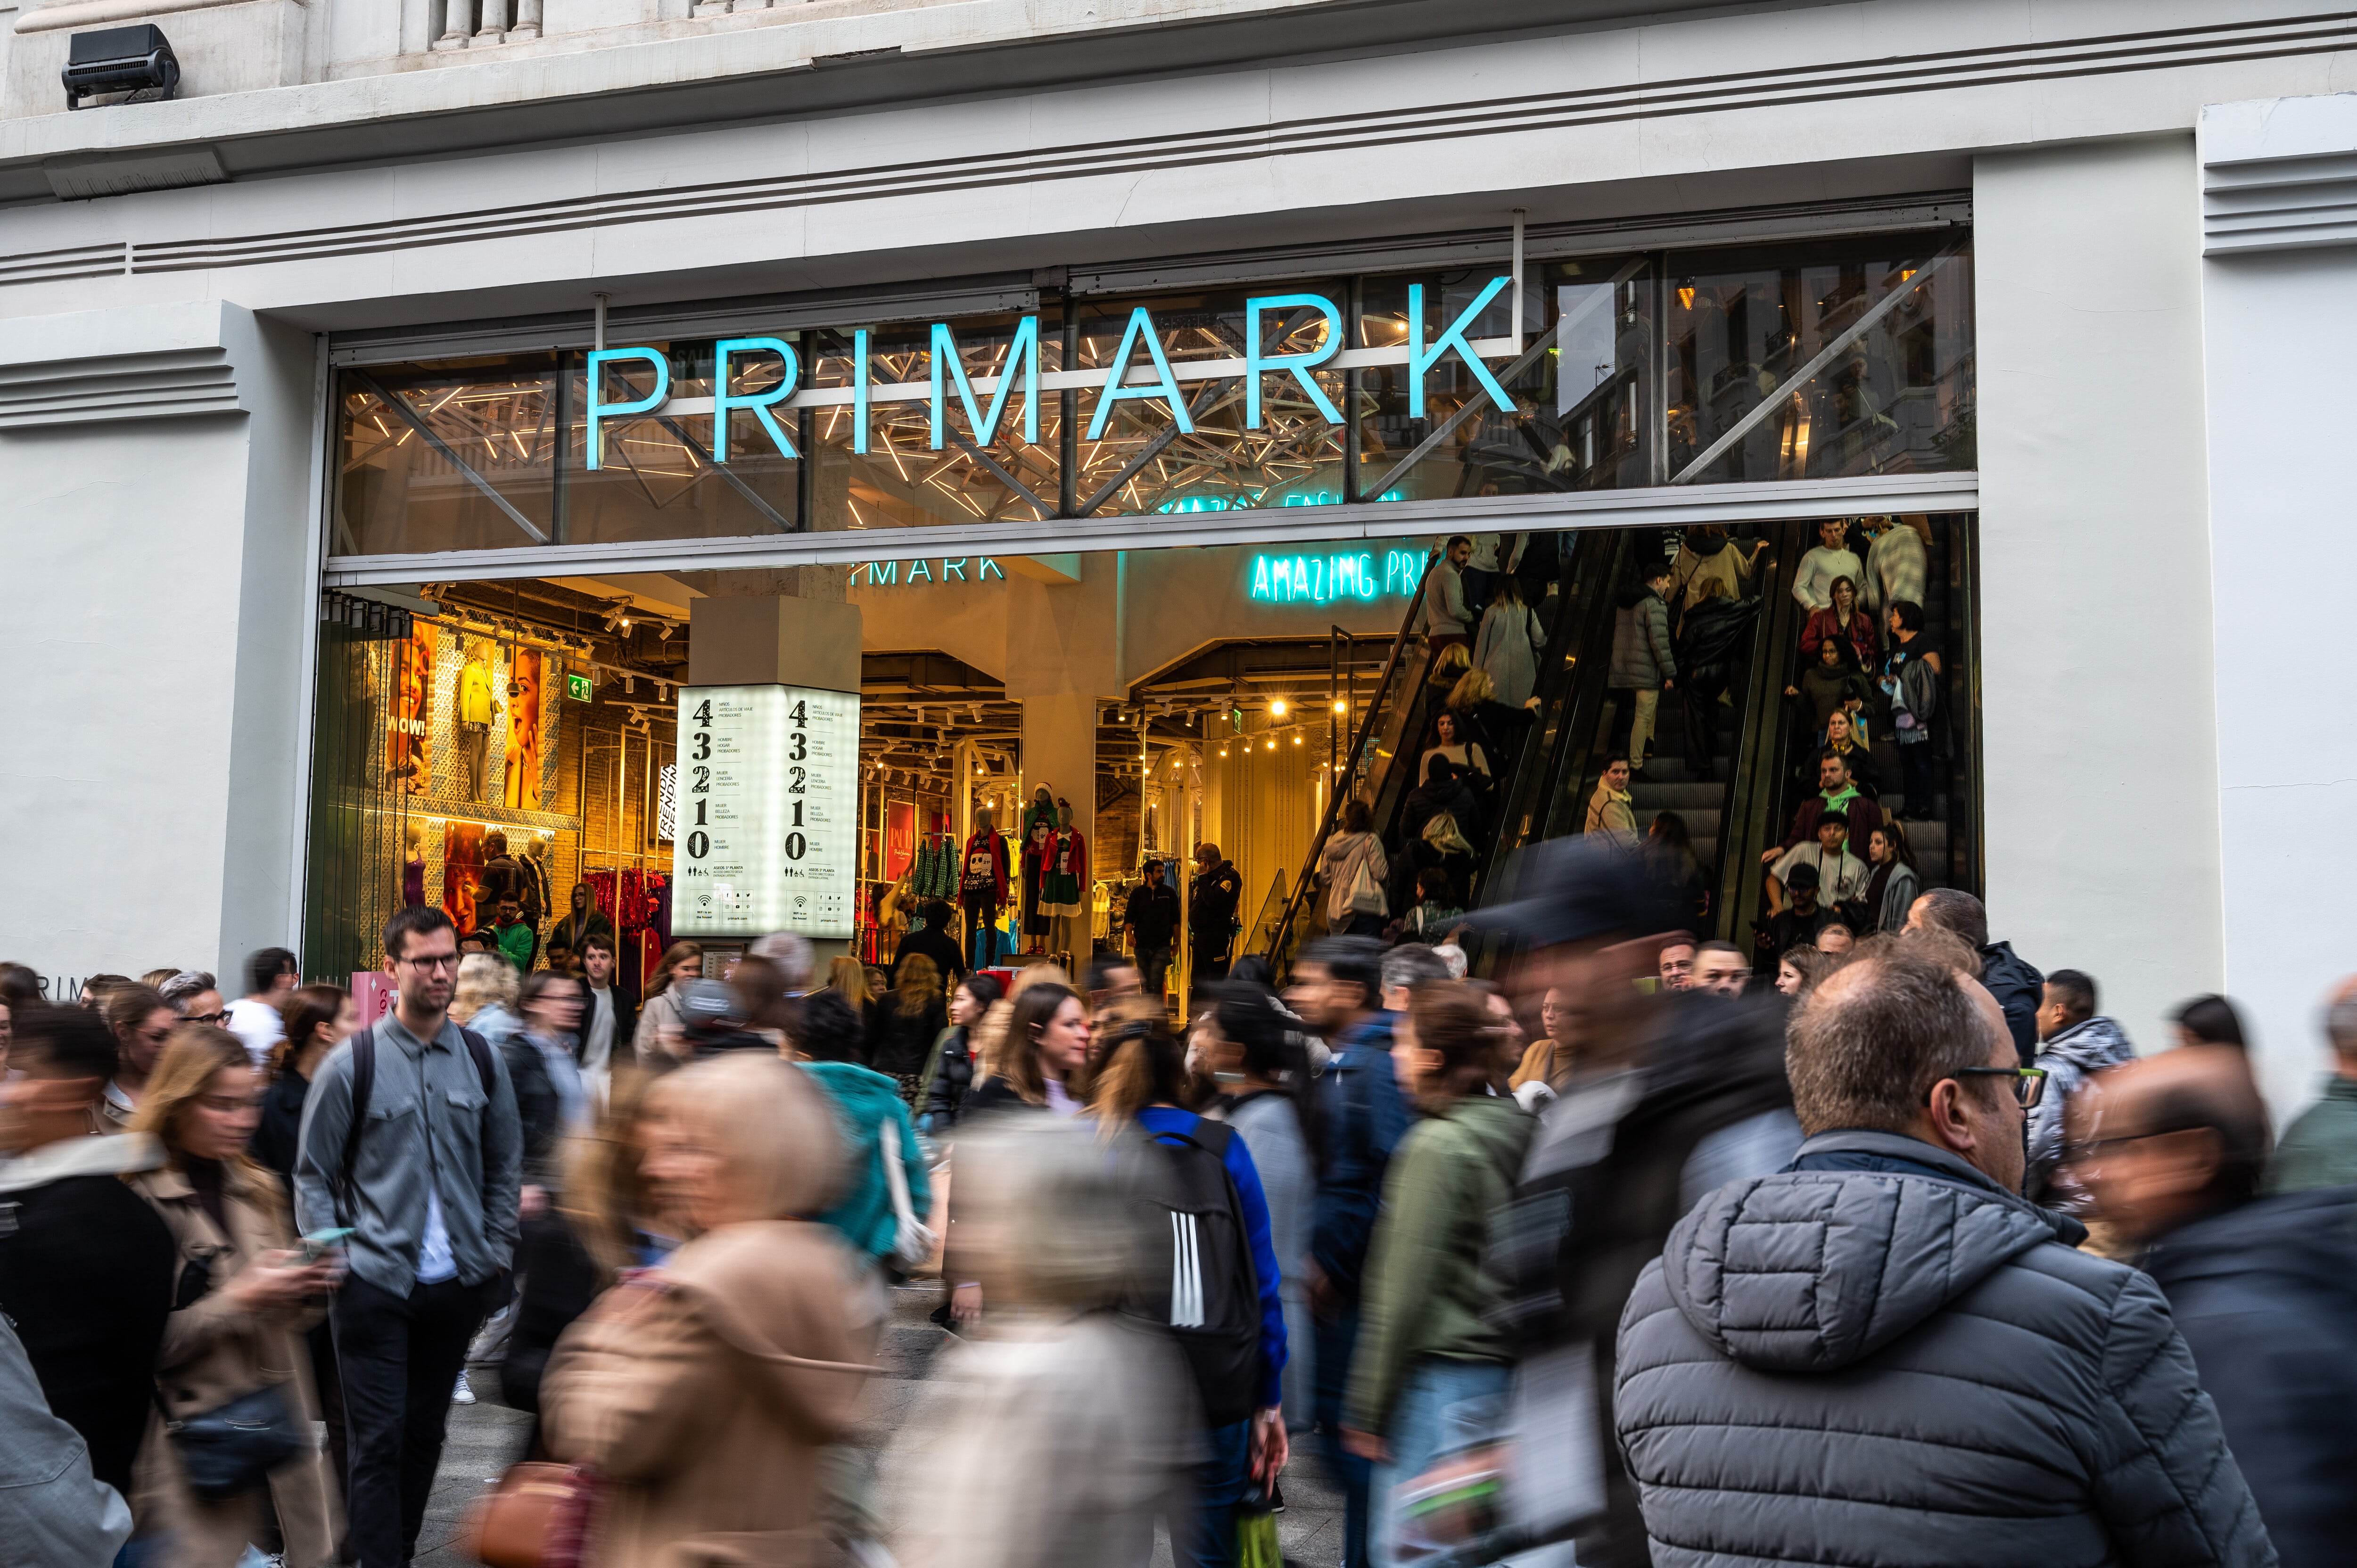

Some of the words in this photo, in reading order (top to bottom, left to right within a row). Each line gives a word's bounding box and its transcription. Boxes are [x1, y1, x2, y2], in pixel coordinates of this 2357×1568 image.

[586, 276, 1519, 471] PRIMARK
[1253, 554, 1374, 602] AMAZING
[1387, 550, 1429, 595] PRI
[387, 714, 425, 736] WOW!
[692, 699, 713, 727] 4
[789, 700, 808, 729] 4
[692, 732, 711, 761] 3
[789, 733, 807, 761] 3
[692, 766, 709, 793] 2
[789, 766, 806, 794] 2
[694, 798, 708, 825] 1
[791, 799, 805, 827] 1
[687, 830, 710, 859] 0
[785, 832, 806, 860] 0
